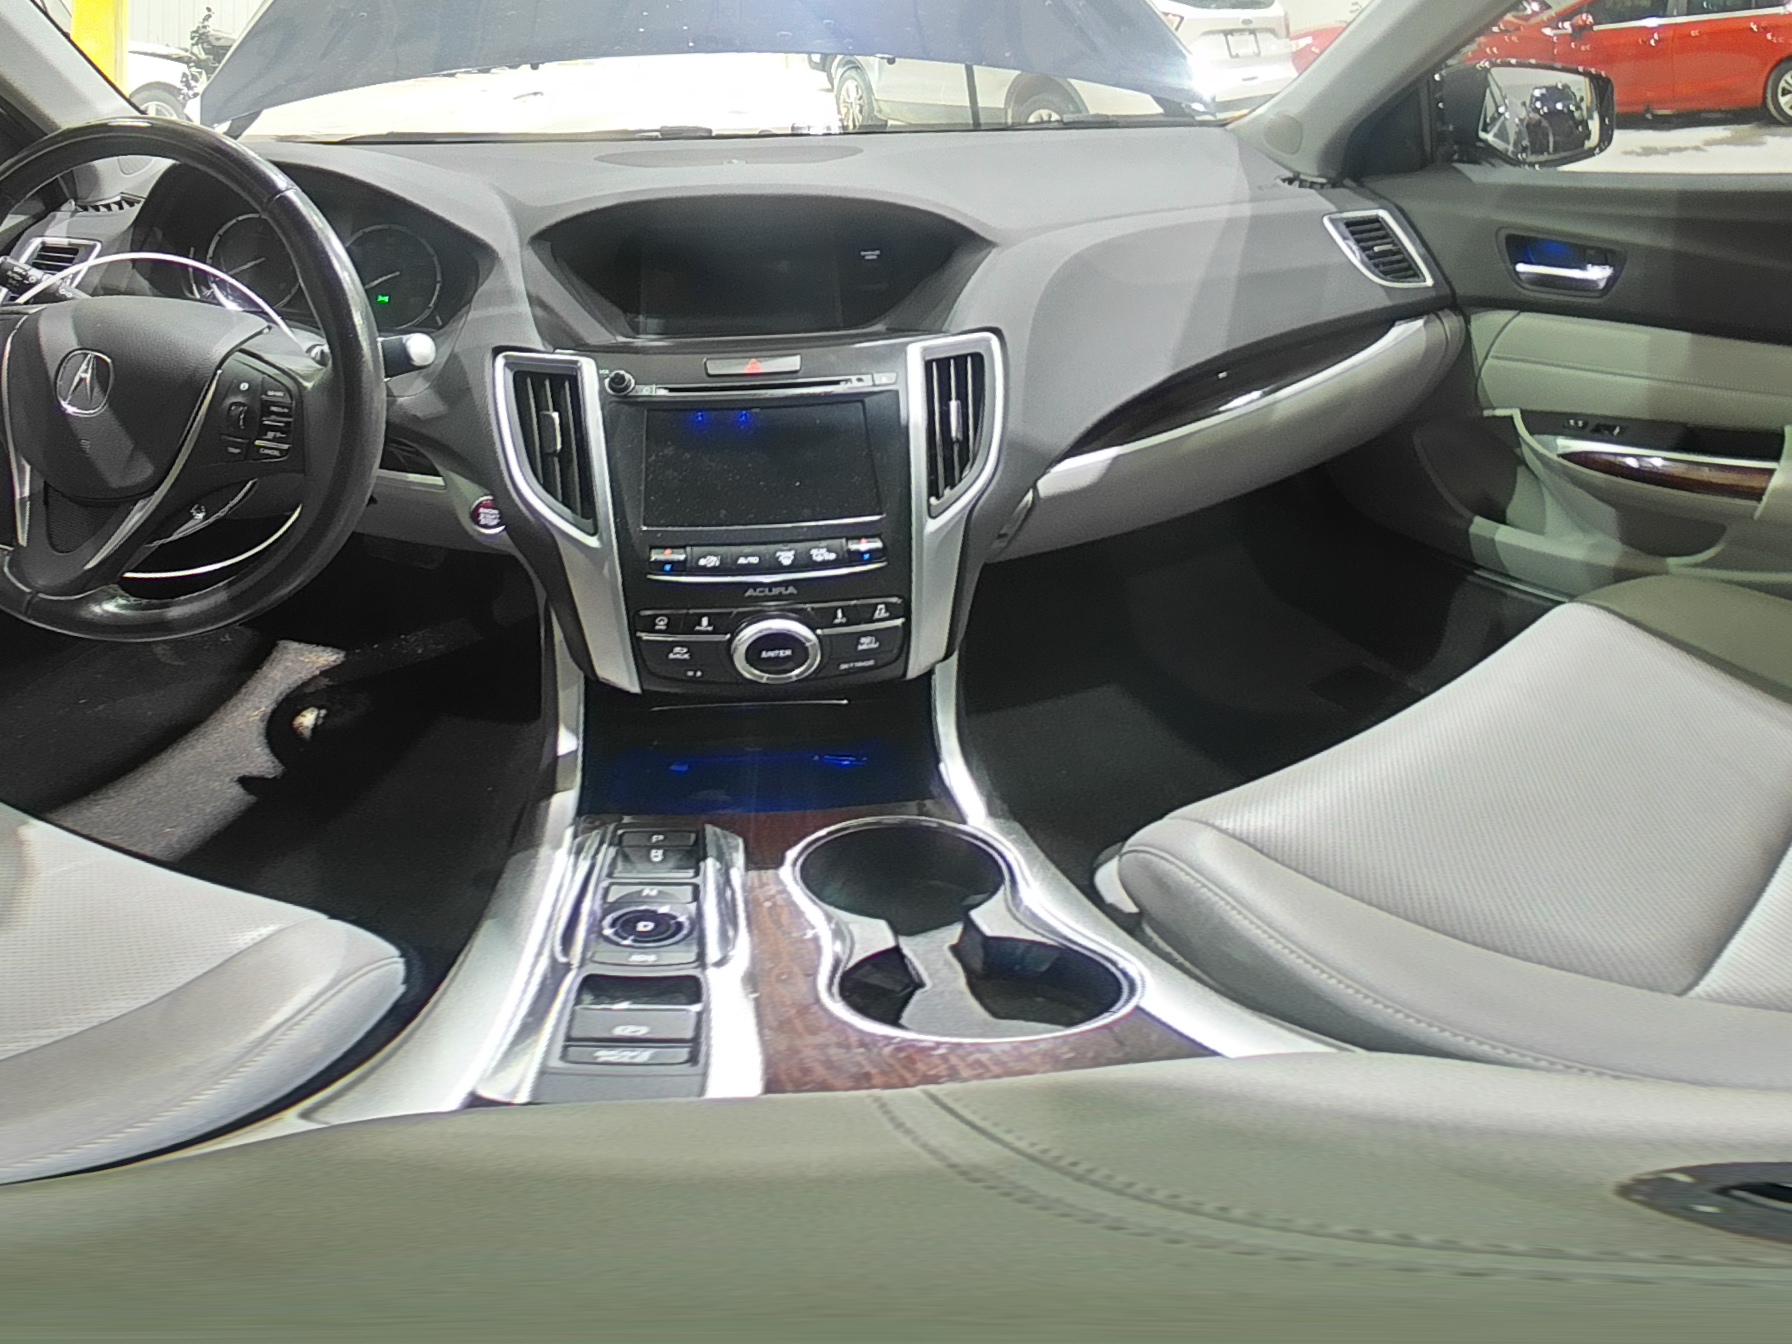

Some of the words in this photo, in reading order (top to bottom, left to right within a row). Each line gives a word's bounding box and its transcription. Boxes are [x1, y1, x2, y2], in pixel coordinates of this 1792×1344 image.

[736, 555, 760, 565] AUTO
[744, 586, 798, 597] ACURA
[760, 648, 792, 658] ENTER
